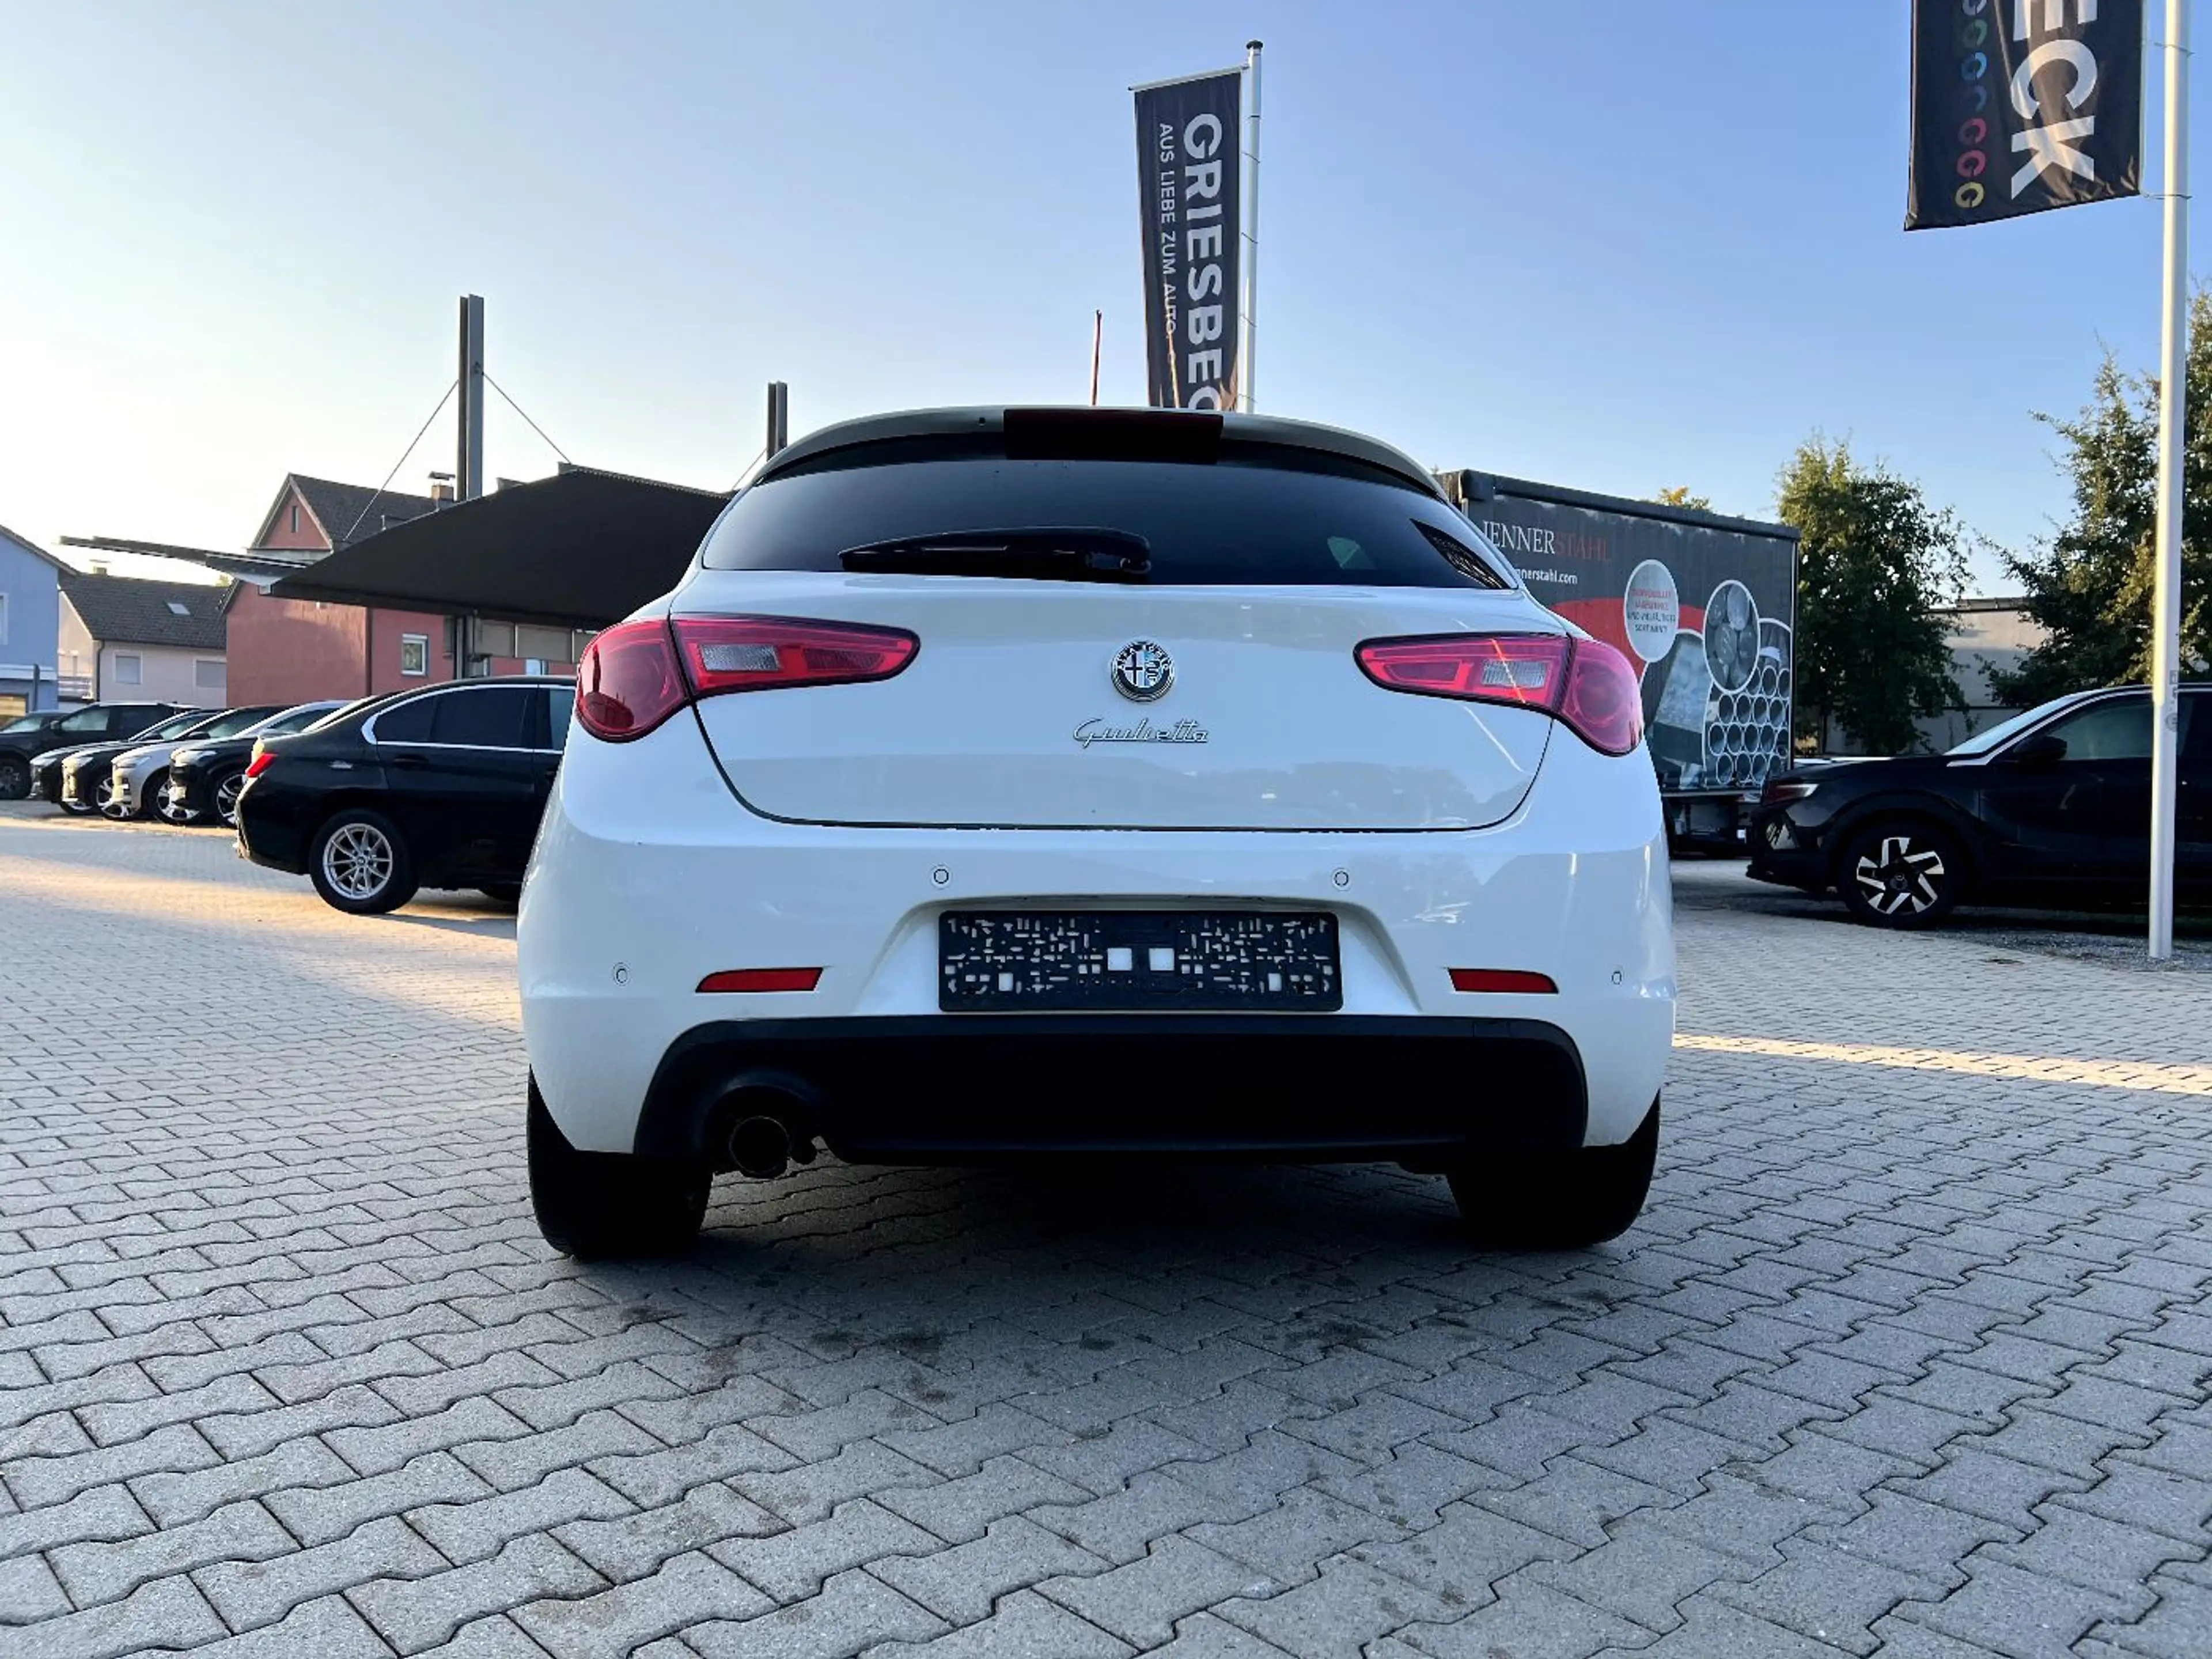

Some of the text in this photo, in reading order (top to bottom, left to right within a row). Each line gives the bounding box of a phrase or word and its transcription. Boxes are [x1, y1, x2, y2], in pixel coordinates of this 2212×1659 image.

[1159, 123, 1175, 163] AUS
[1161, 171, 1176, 224] LIEBE
[1161, 230, 1177, 275] ZUM
[1073, 717, 1209, 749] Giulietta
